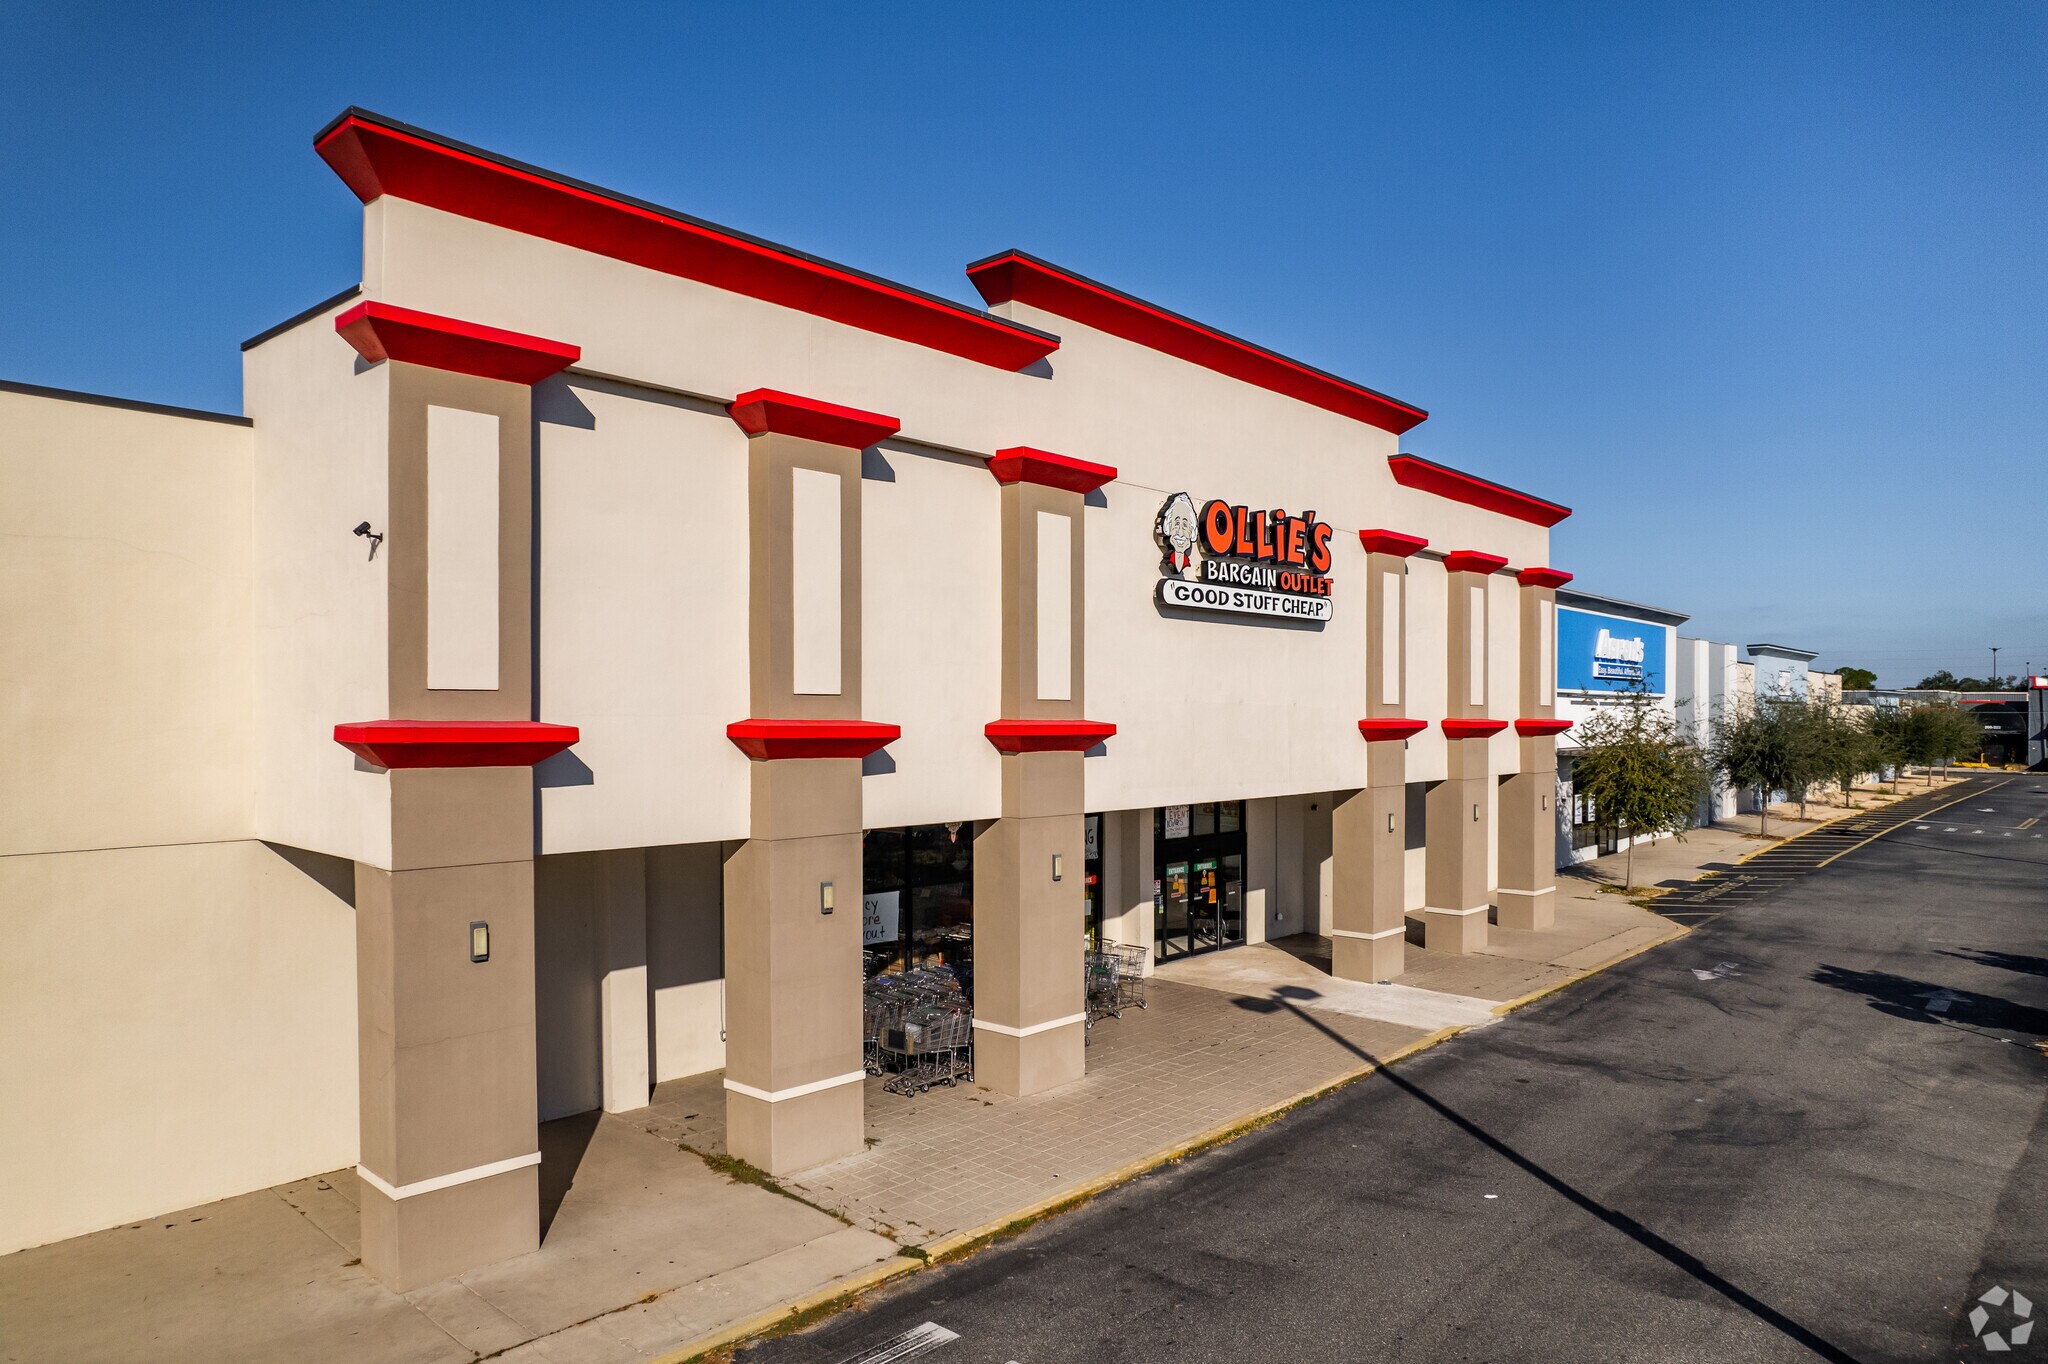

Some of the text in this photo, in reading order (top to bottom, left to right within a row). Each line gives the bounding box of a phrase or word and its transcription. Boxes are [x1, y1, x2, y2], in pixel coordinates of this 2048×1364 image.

[1207, 560, 1334, 596] BARGAIN OUTLET
[1233, 592, 1280, 612] STUFF
